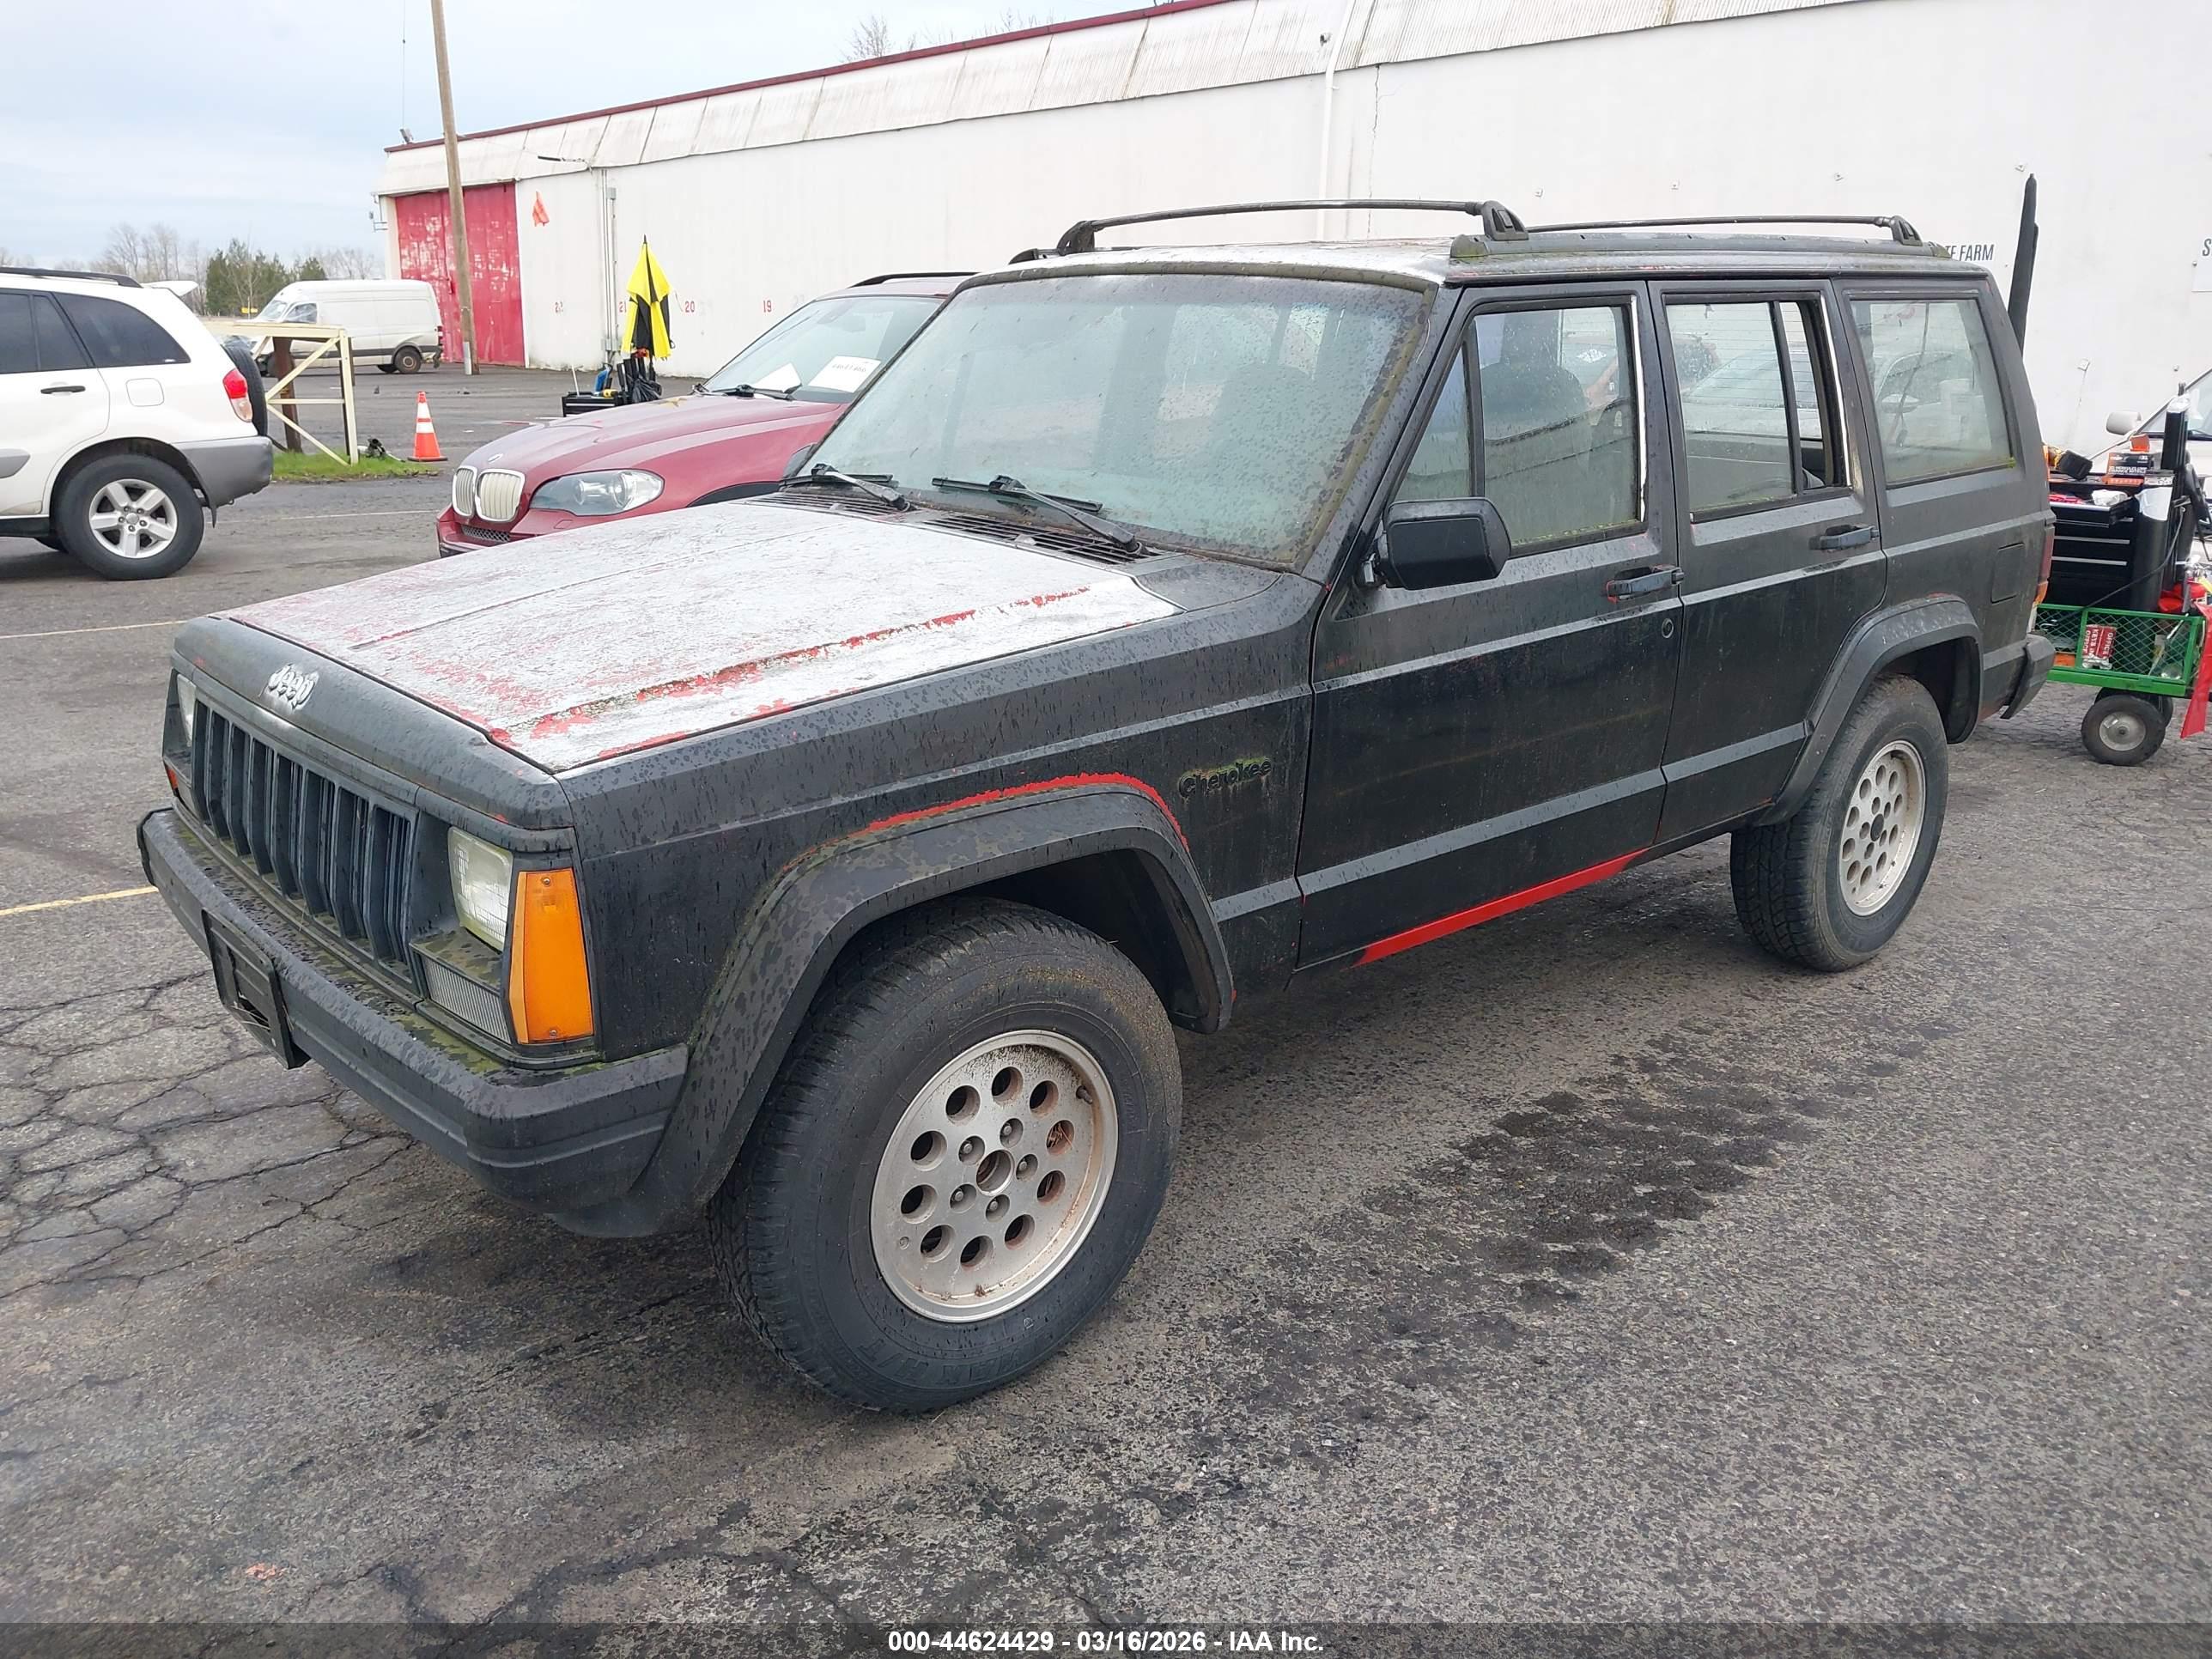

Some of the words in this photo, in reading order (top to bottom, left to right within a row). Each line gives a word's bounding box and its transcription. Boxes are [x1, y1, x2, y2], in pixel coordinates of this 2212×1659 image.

[1959, 244, 1995, 261] FARM
[684, 301, 696, 313] 20
[763, 301, 772, 313] 19
[2090, 629, 2100, 647] KEYS
[2102, 632, 2114, 655] OFFICE
[267, 663, 317, 709] Jeep
[1179, 757, 1273, 799] Cherokee
